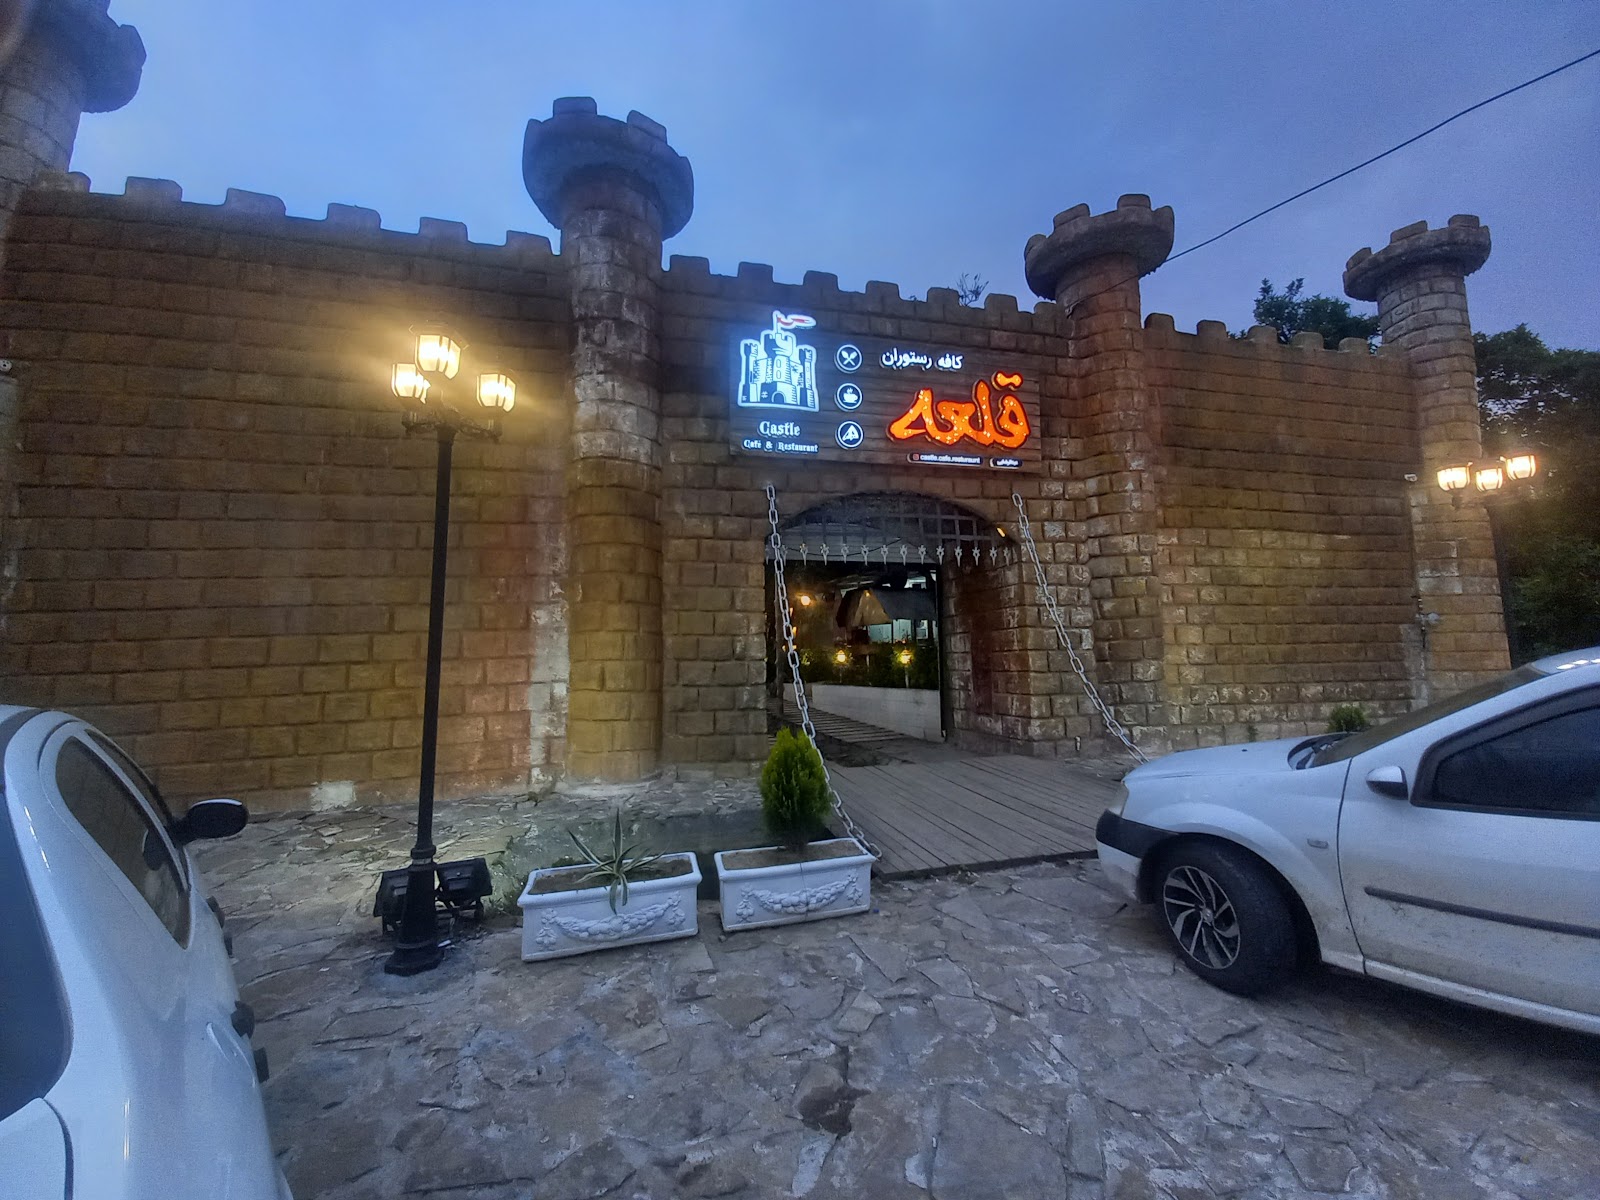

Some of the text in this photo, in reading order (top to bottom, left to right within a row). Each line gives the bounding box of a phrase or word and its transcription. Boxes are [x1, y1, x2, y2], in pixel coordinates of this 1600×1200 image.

[881, 347, 963, 369] کافه رستوران
[889, 371, 1031, 449] قلعه
[759, 420, 801, 437] Castle
[765, 440, 774, 449] &
[777, 441, 819, 452] Restaurant
